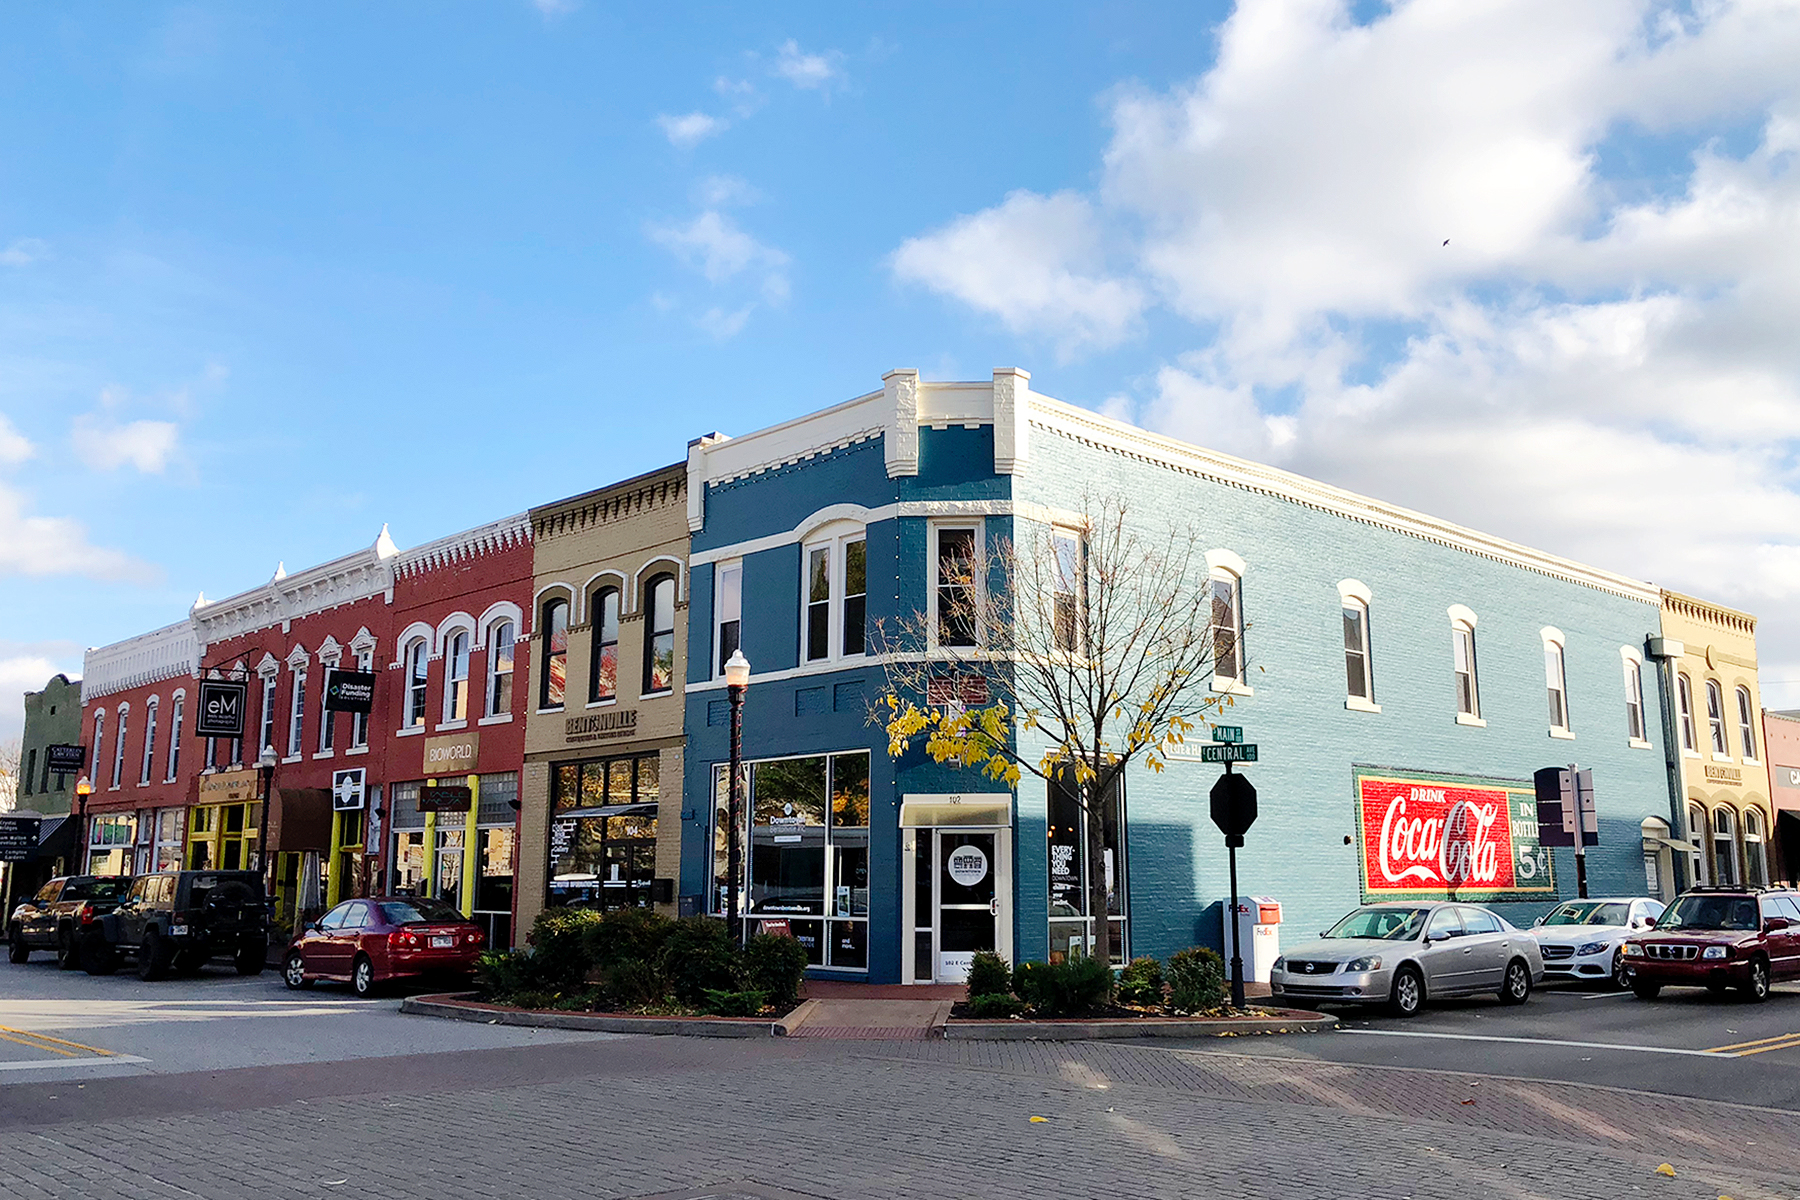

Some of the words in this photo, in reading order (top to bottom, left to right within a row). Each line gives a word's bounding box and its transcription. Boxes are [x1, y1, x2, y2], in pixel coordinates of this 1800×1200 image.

[342, 683, 372, 691] Disaster
[341, 689, 371, 699] Funding
[208, 695, 237, 714] eM
[565, 709, 638, 735] BENTONVILLE
[1217, 727, 1235, 741] MAIN
[1206, 746, 1246, 761] CENTRAL
[949, 795, 961, 804] 102
[1410, 788, 1446, 803] DRINK
[1519, 802, 1535, 817] IN
[770, 815, 806, 825] Downtown
[627, 826, 638, 836] 104
[1379, 796, 1499, 883] Coca-Cola
[1051, 845, 1075, 855] EVERY-
[1052, 853, 1073, 861] THING
[1051, 860, 1066, 868] YOU
[1052, 867, 1070, 875] NEED
[1229, 904, 1249, 913] FEx
[1256, 927, 1272, 936] FedEx
